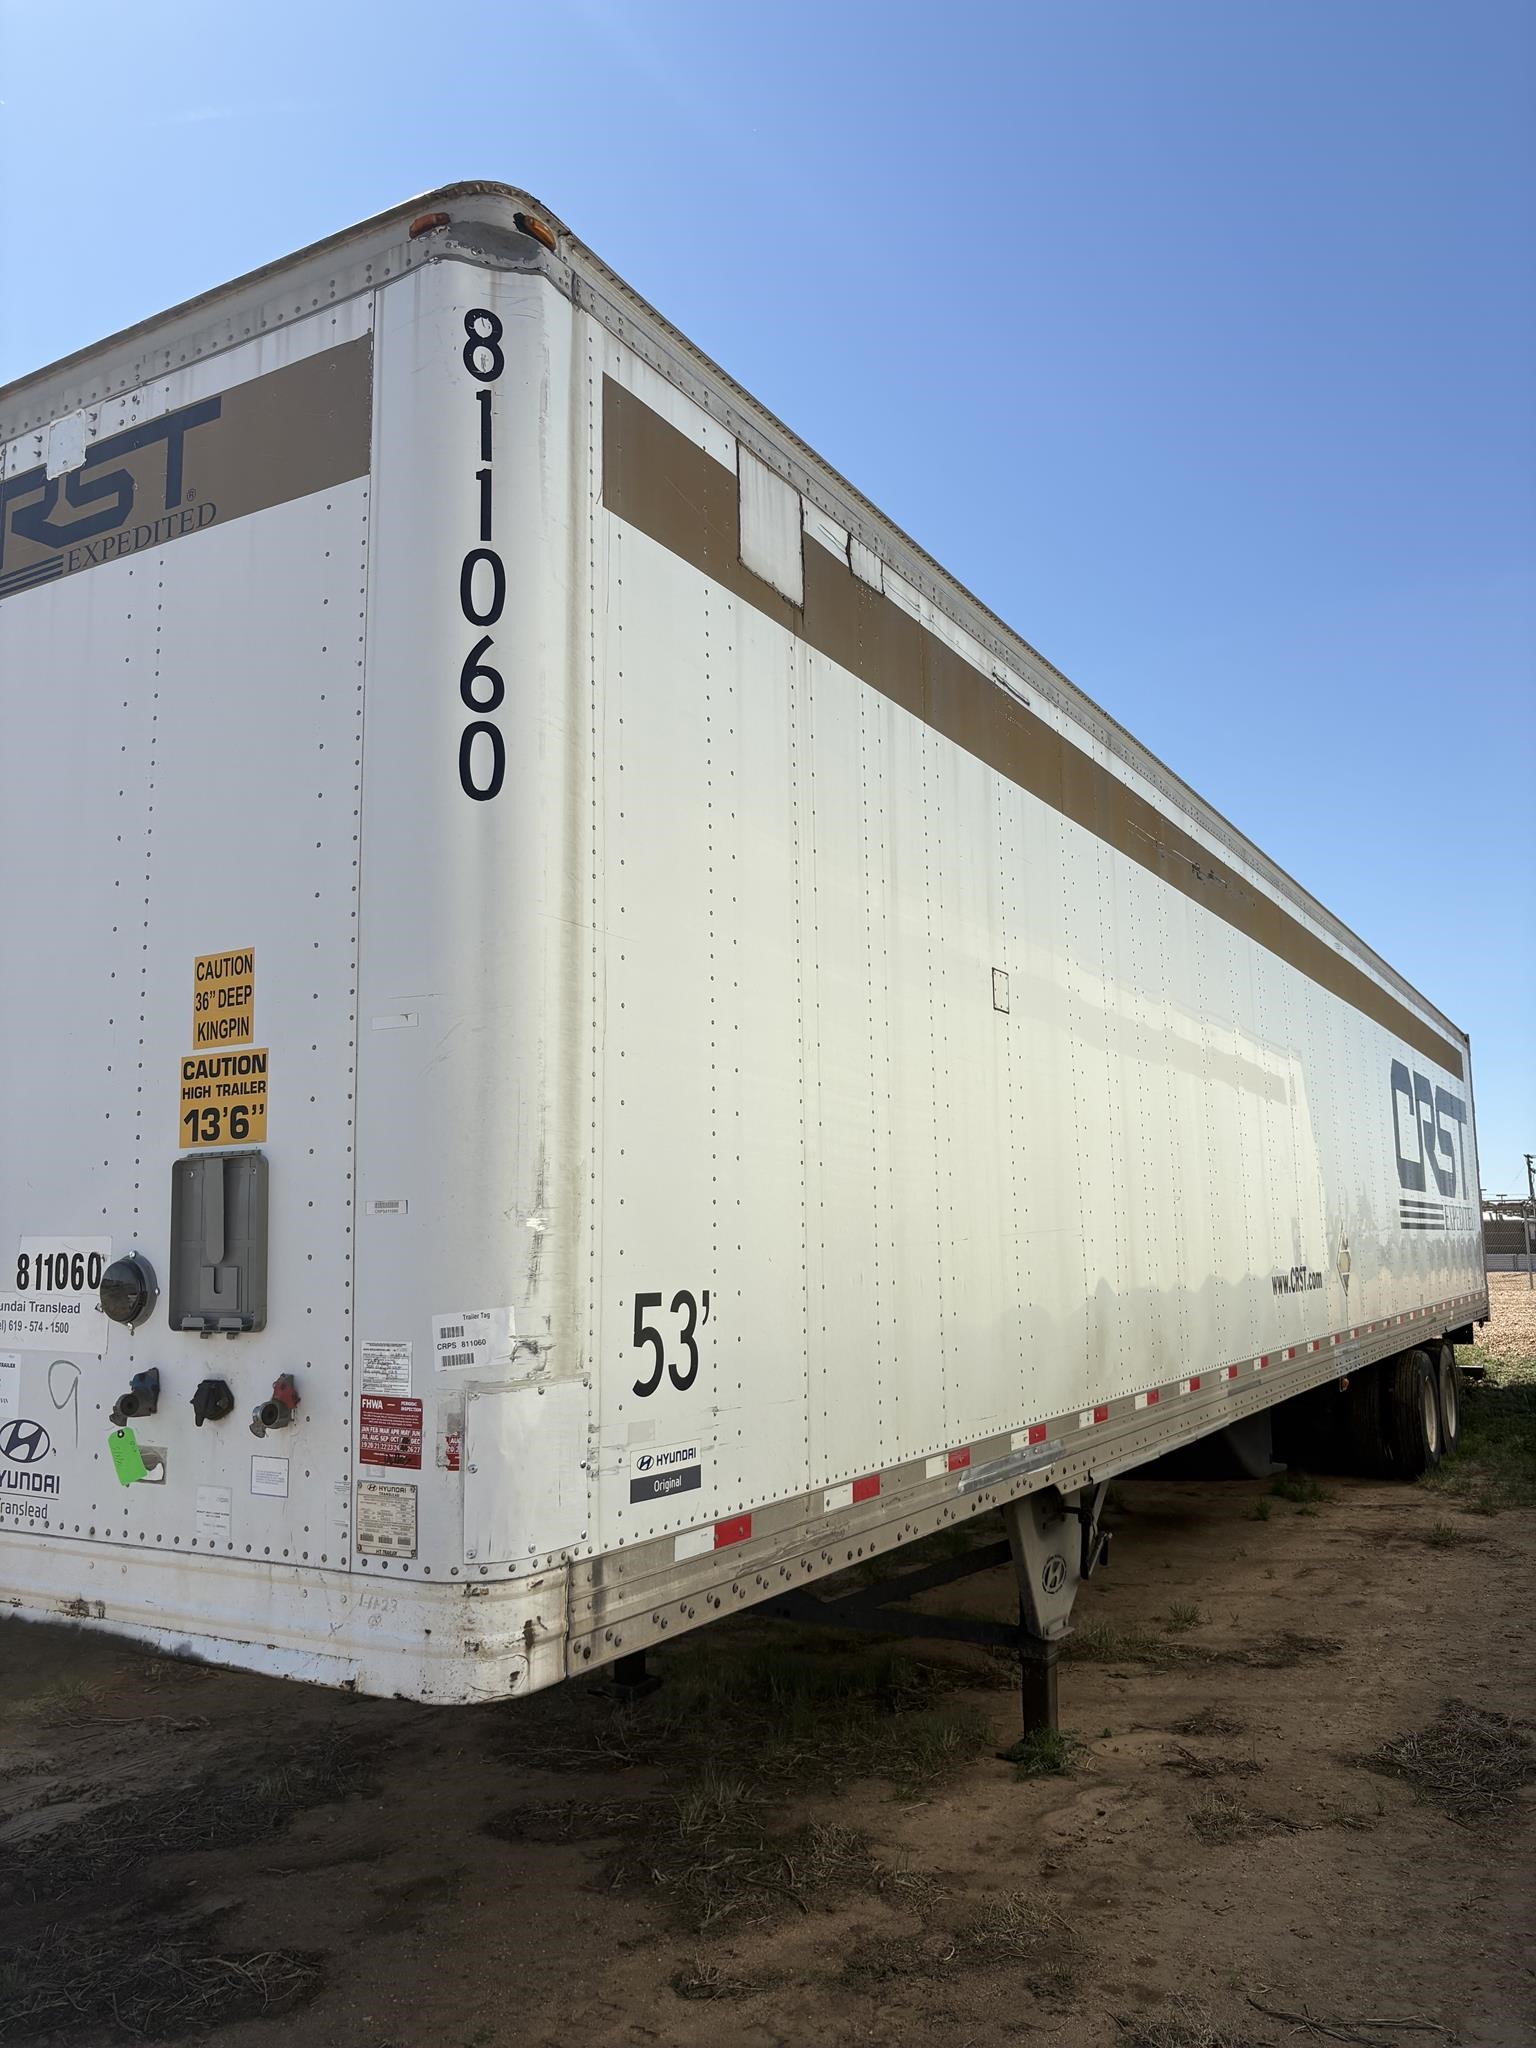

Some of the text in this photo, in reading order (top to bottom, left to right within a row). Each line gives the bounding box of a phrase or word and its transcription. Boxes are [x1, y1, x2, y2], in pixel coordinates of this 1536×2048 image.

[66, 502, 217, 573] EXPEDITED
[459, 308, 506, 802] 811060
[196, 953, 253, 981] CAUTION
[218, 984, 252, 1009] DEEP
[197, 1016, 250, 1042] KINGPIN
[183, 1053, 267, 1081] CAUTION
[182, 1080, 266, 1100] HIGH TRAILER
[1390, 1058, 1467, 1200] CRST
[16, 1252, 101, 1291] 811060
[1271, 1265, 1323, 1295] www.CRST.com
[29, 1301, 81, 1314] Translead
[463, 1312, 491, 1321] Trailer Tag
[8, 1320, 23, 1332] 619
[29, 1321, 43, 1332] 574
[51, 1322, 69, 1333] 1500
[436, 1339, 487, 1350] CRPS 811060
[361, 1399, 384, 1410] FHWA
[655, 1446, 697, 1467] HYUNDAI
[379, 1485, 407, 1493] HYUNDAI
[653, 1474, 682, 1493] Original
